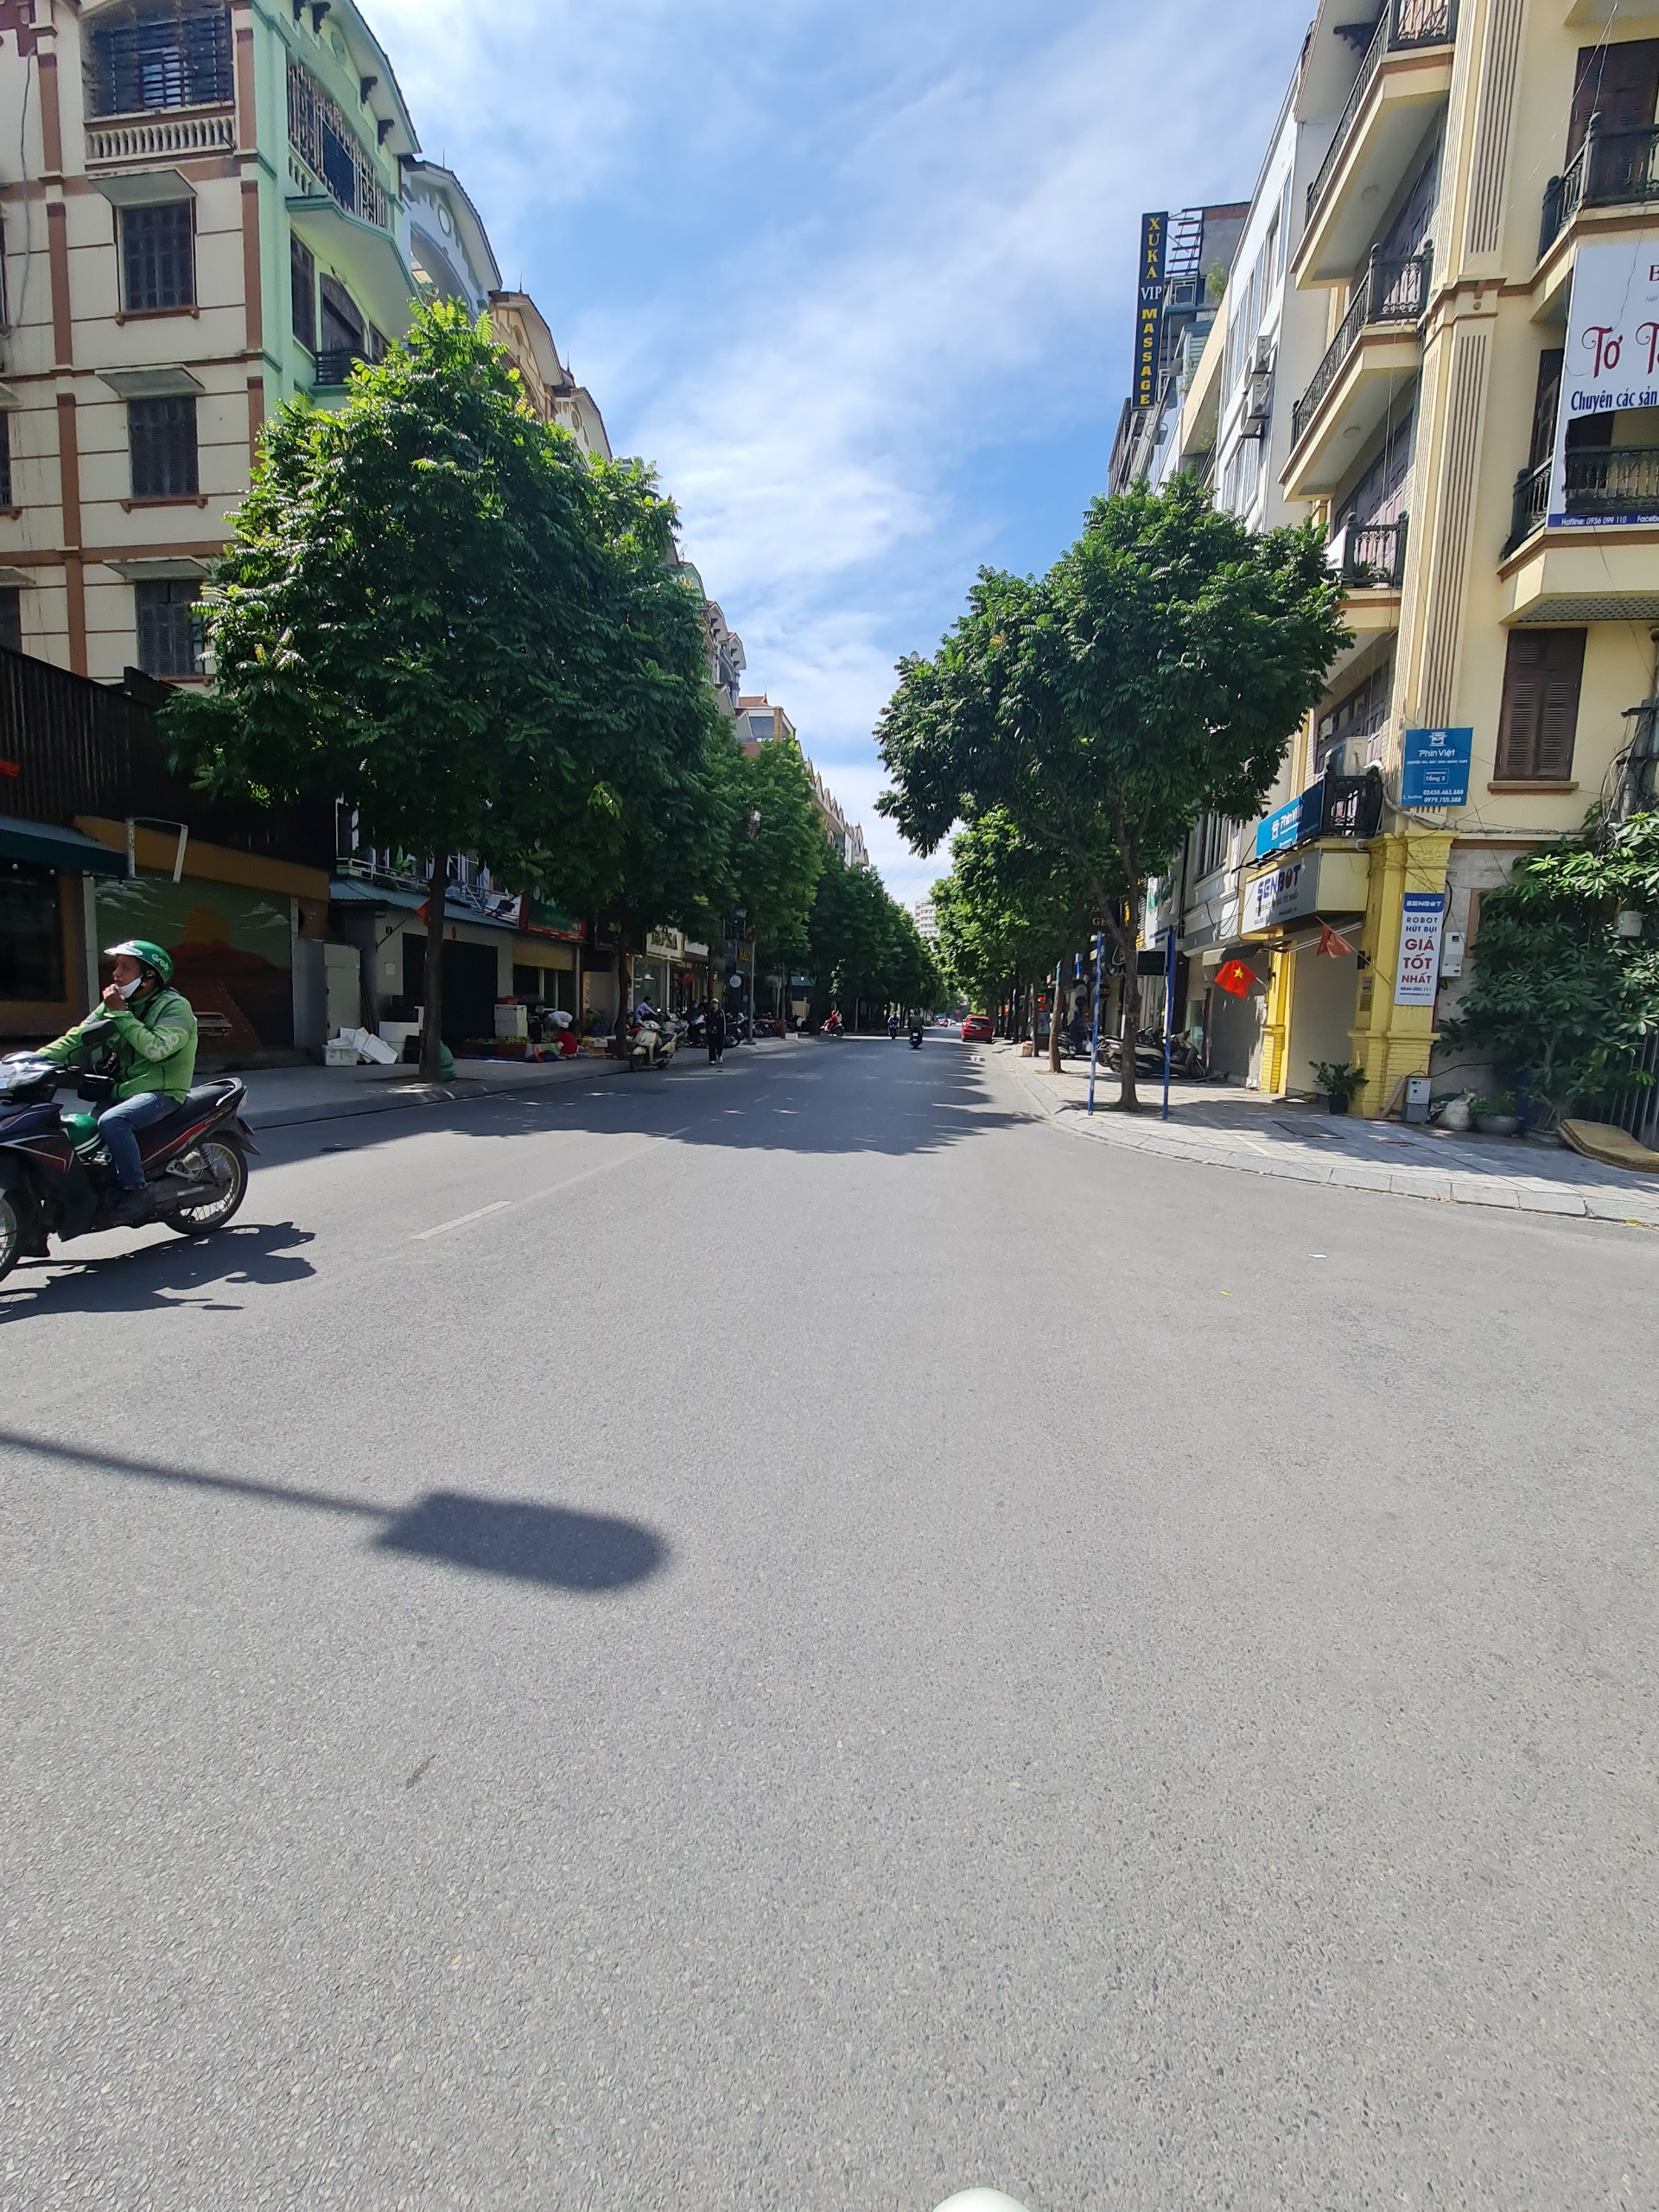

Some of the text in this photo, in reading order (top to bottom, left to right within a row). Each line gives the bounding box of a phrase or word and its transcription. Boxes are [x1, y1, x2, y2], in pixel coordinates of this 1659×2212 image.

[1140, 217, 1162, 405] XUKA VIP MASSAGE
[1581, 321, 1659, 379] Tơ T
[1570, 385, 1658, 413] Chuyên các sản
[1419, 748, 1456, 758] Phin Việt
[1405, 924, 1438, 935] HÚT BỤI
[1404, 935, 1434, 951] GIÁ
[151, 953, 169, 971] Grab
[1403, 952, 1433, 969] TỐT
[1401, 971, 1432, 984] NHẤT
